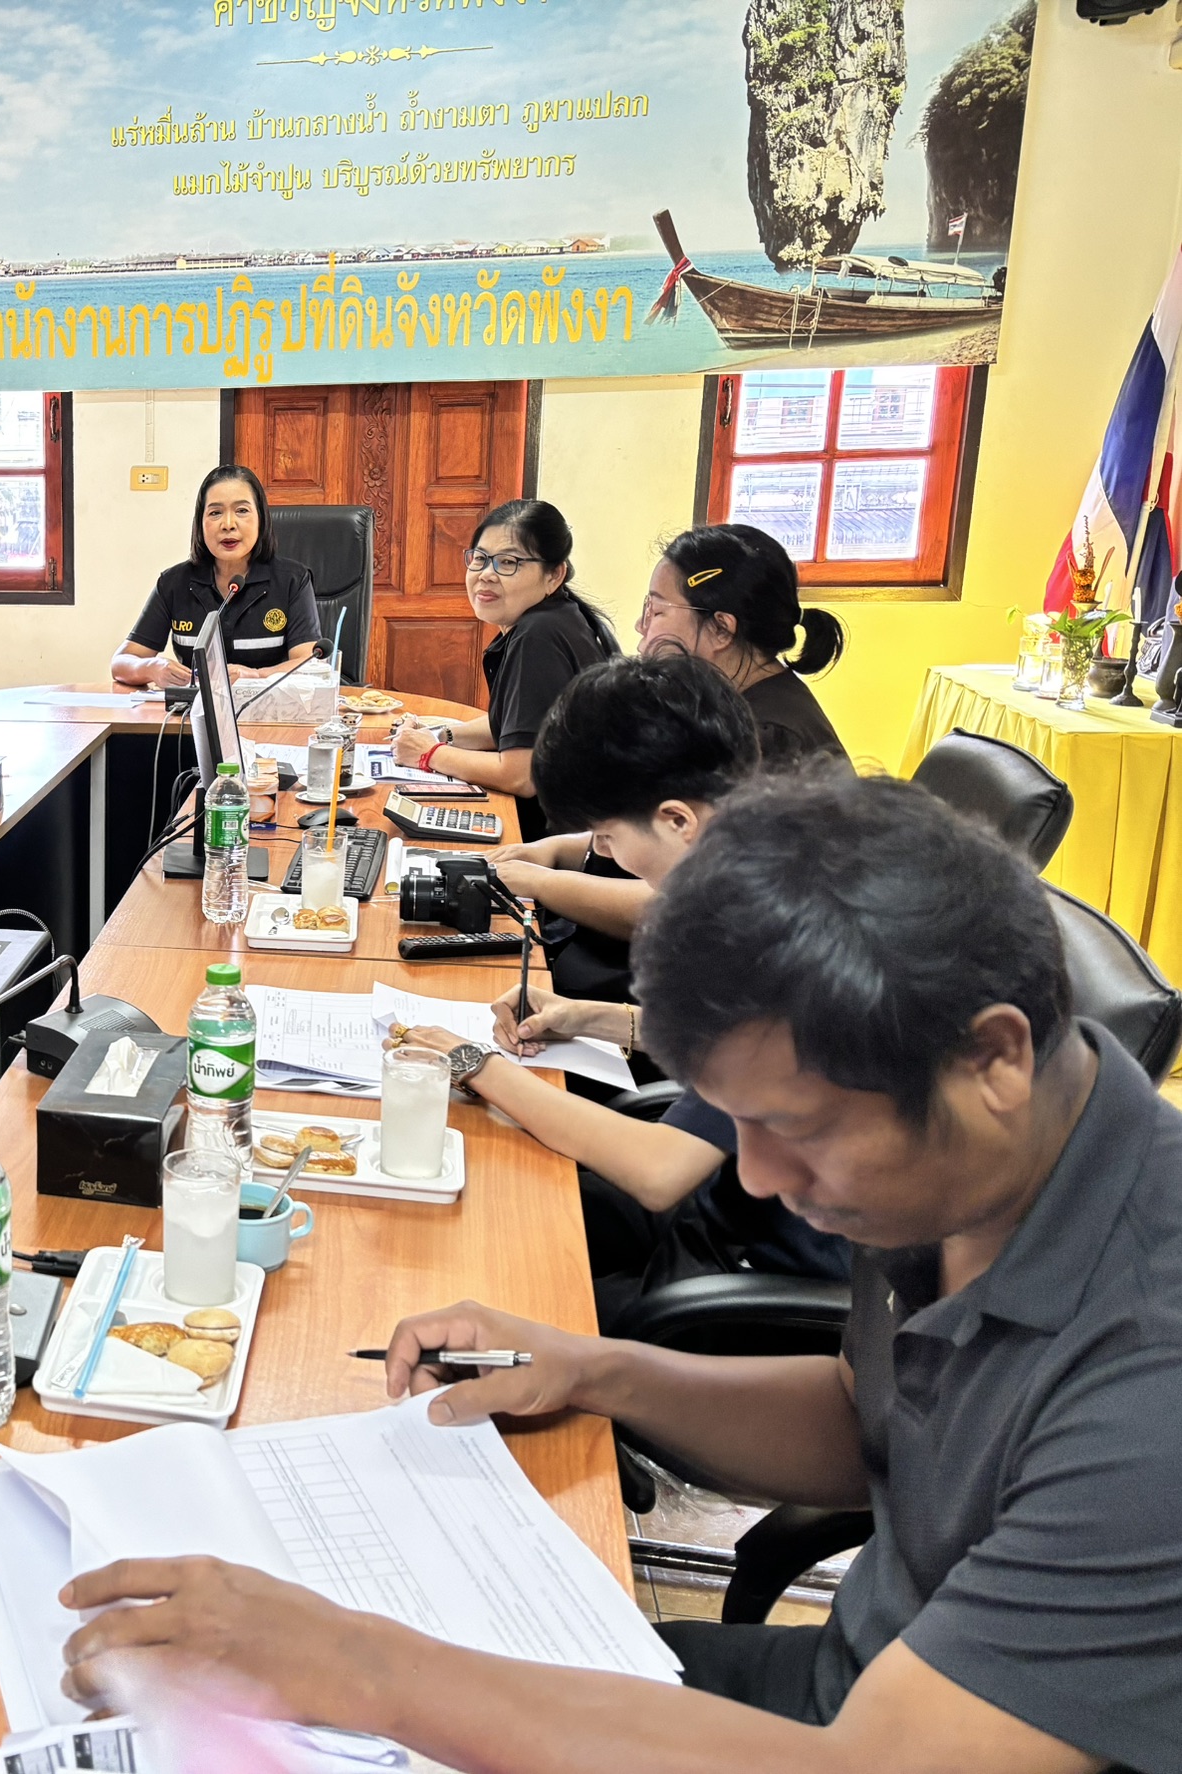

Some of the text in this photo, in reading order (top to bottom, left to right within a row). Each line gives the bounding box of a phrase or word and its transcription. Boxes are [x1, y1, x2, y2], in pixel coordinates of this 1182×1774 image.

[111, 90, 649, 147] แร่หมื่นล้าน บ้านกลางน้ำ ถ้ำงามตา ภูผาแปลก
[173, 148, 577, 200] แมกไม้จำปูน บริบูรณ์ด้วยทรัพยากร
[194, 1055, 236, 1078] น้ำทิพย์
